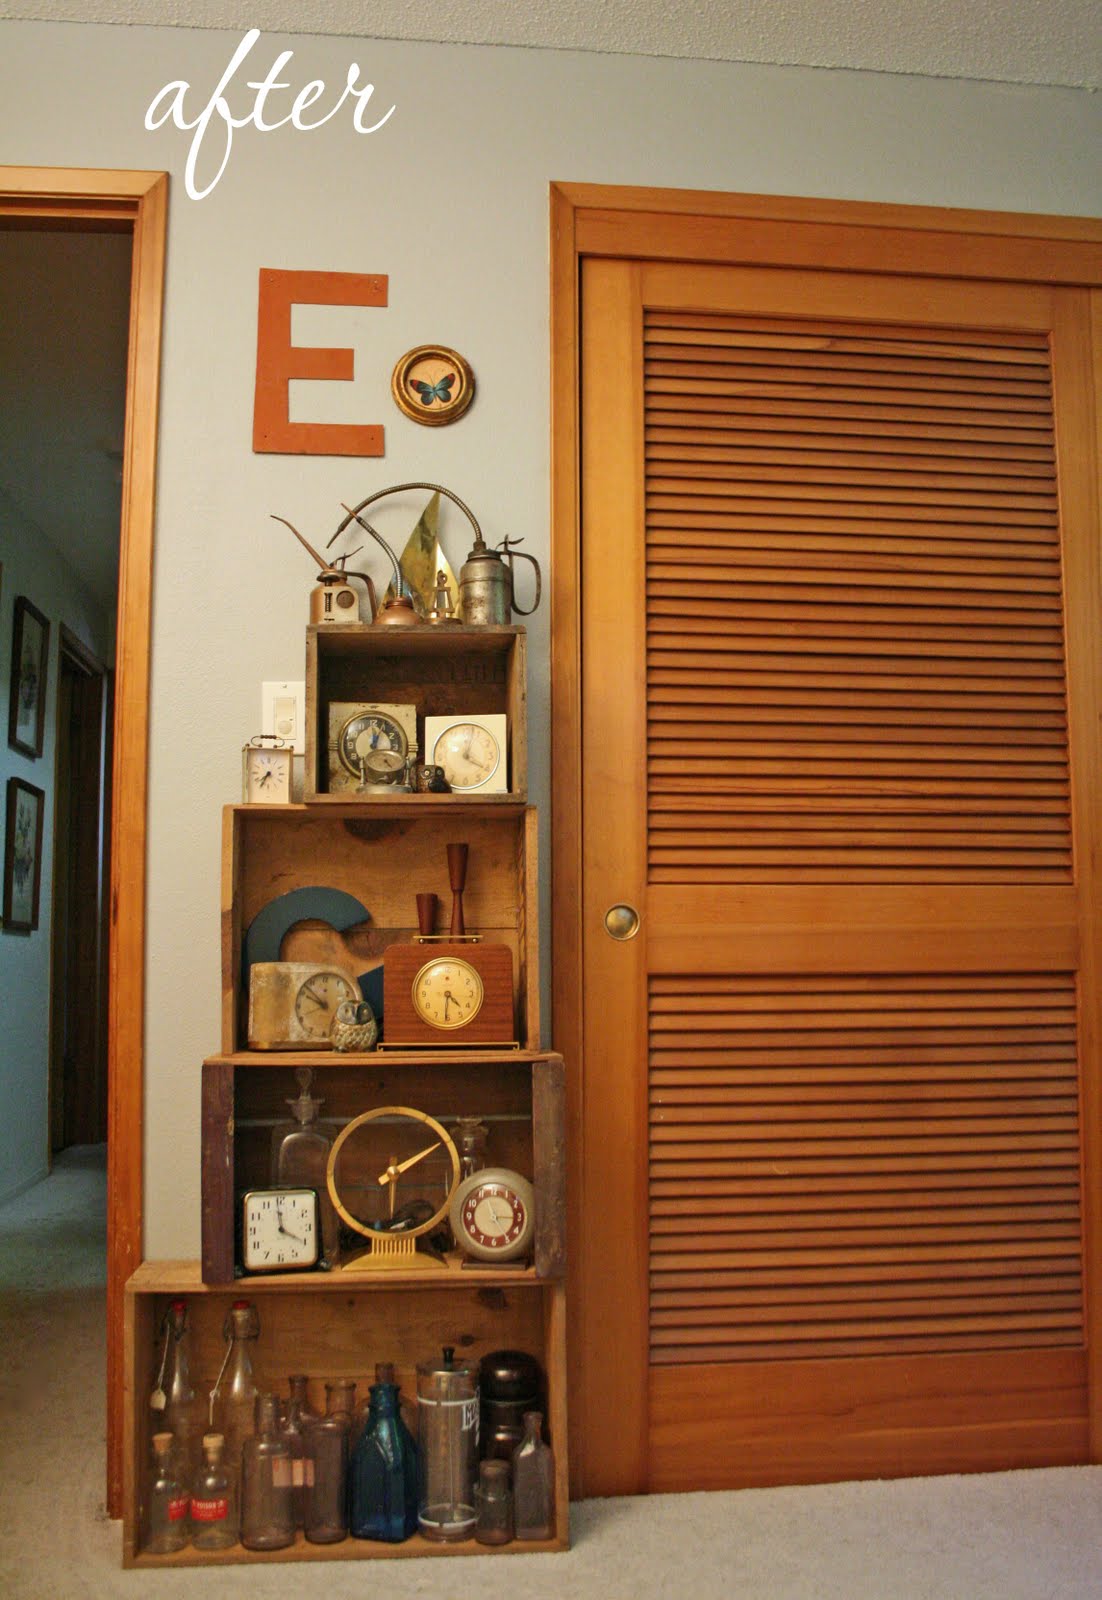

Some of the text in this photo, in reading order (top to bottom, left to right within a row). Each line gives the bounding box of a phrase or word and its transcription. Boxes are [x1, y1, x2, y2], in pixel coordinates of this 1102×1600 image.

[253, 267, 388, 457] E
[463, 777, 468, 785] 6
[478, 1189, 484, 1198] 11
[491, 1188, 498, 1196] 12
[263, 1201, 270, 1209] 11
[469, 1199, 477, 1208] 10
[514, 1200, 518, 1209] 2
[466, 1212, 472, 1220] 9
[517, 1213, 522, 1221] 3
[470, 1225, 476, 1234] 8
[513, 1226, 519, 1234] 4
[480, 1235, 484, 1244] 7
[264, 1250, 270, 1259] 7
